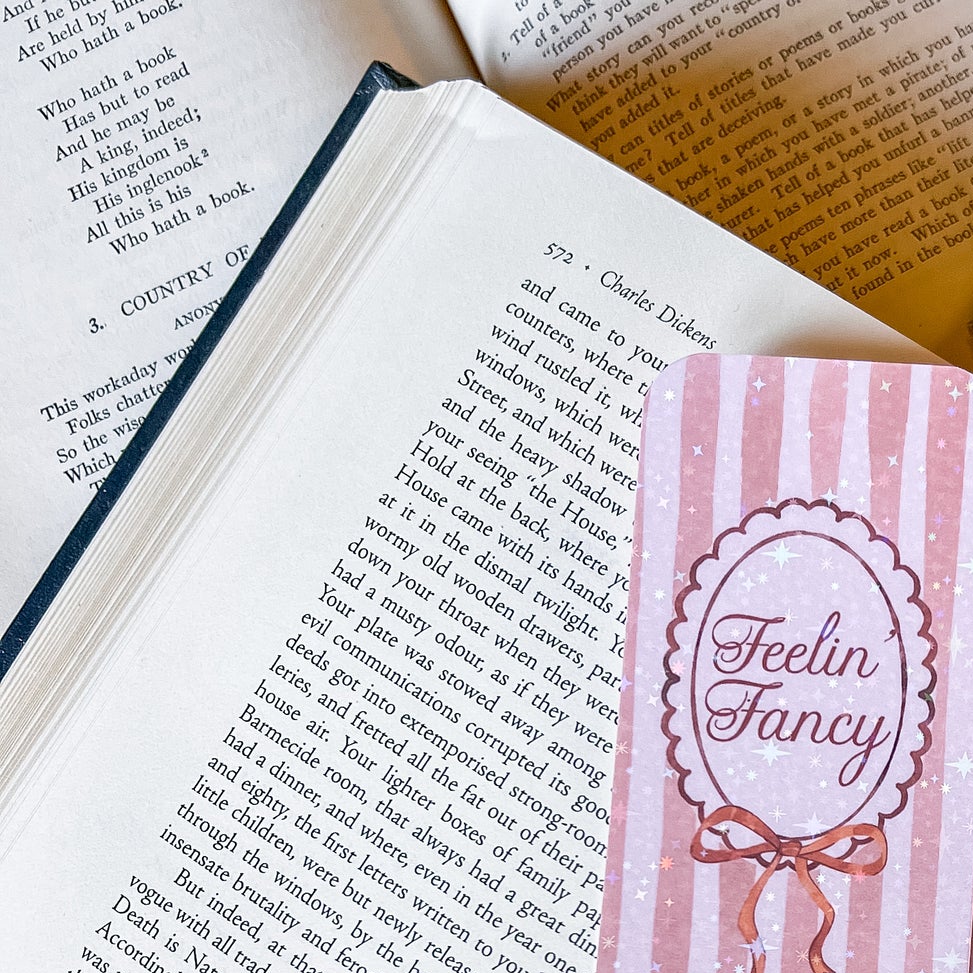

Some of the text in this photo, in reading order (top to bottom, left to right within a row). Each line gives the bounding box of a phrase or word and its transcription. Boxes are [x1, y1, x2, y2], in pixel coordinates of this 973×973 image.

[39, 0, 183, 72] Who hath a book.
[36, 46, 177, 121] Who hath a book
[61, 61, 190, 134] Has but to read
[56, 97, 175, 162] And he may be
[81, 107, 201, 174] A king, indeed;
[67, 137, 189, 202] His kingdom is
[92, 193, 123, 214] His
[87, 185, 192, 244] All this is his
[108, 181, 255, 255] Who hath a book.
[800, 232, 837, 256] have
[840, 209, 877, 234] more
[879, 190, 914, 211] than
[917, 169, 950, 192] their
[882, 211, 915, 237] read
[919, 208, 929, 218] a
[929, 185, 968, 211] book
[910, 213, 959, 241] Which
[89, 244, 249, 334] 3. COUNTRY OF
[896, 261, 914, 274] in
[917, 245, 942, 262] the
[521, 279, 625, 346] and came to
[543, 244, 717, 349] 572 Charles Dickens
[491, 325, 611, 410] wind rustled it,
[505, 303, 633, 385] counters, where
[40, 361, 157, 422] This workaday
[457, 369, 595, 466] Street, and which
[365, 515, 584, 669] wormy old wooden drawers,
[704, 678, 891, 787] Fancy
